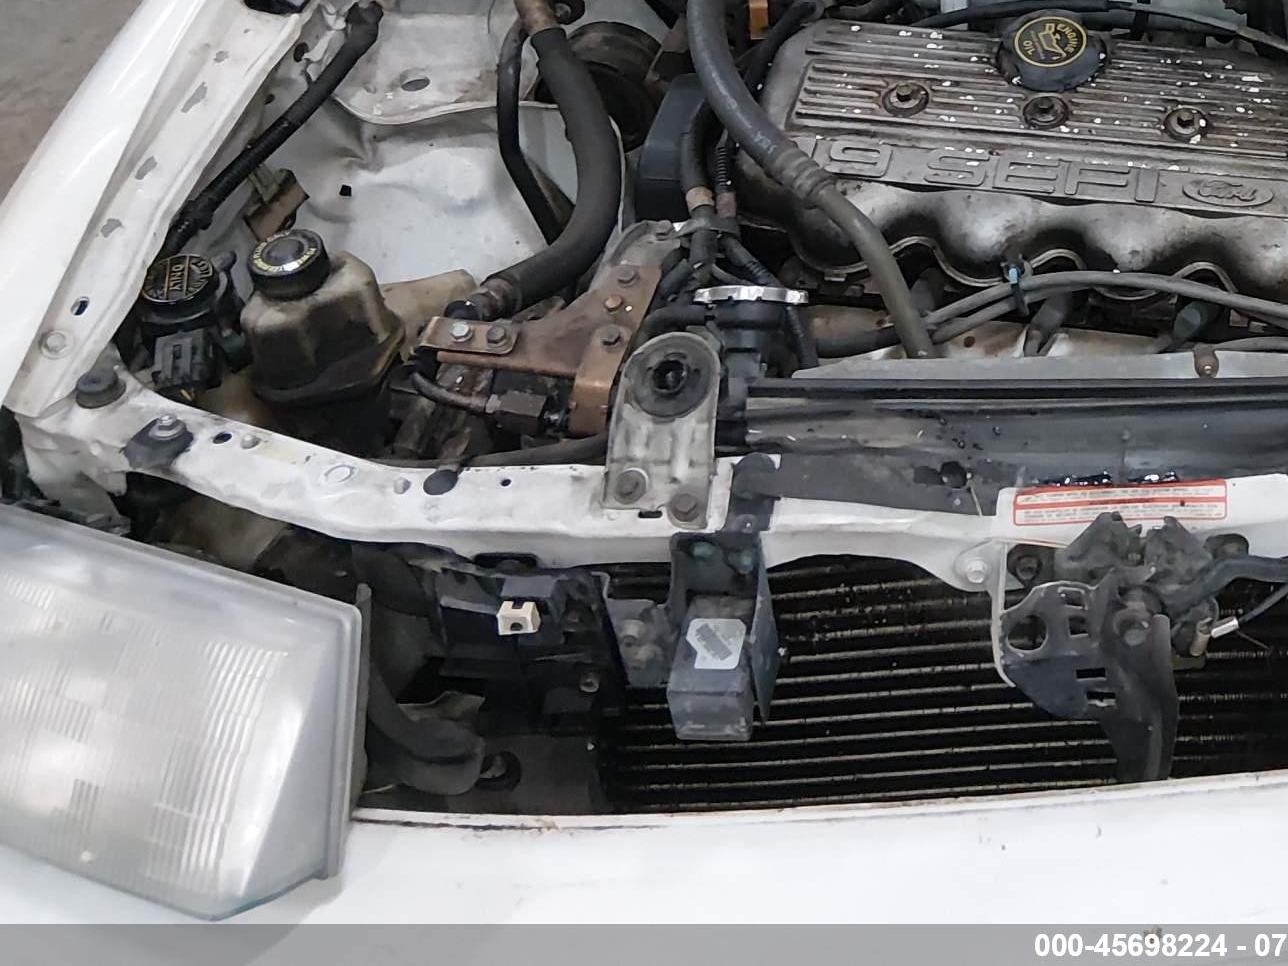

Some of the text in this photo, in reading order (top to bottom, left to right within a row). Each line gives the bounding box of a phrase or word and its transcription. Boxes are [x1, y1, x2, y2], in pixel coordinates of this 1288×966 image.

[1023, 40, 1037, 55] OIL
[1056, 23, 1079, 53] ENGINE
[924, 147, 1161, 202] SEFI
[1197, 179, 1258, 202] Ford
[169, 264, 184, 291] ONLY
